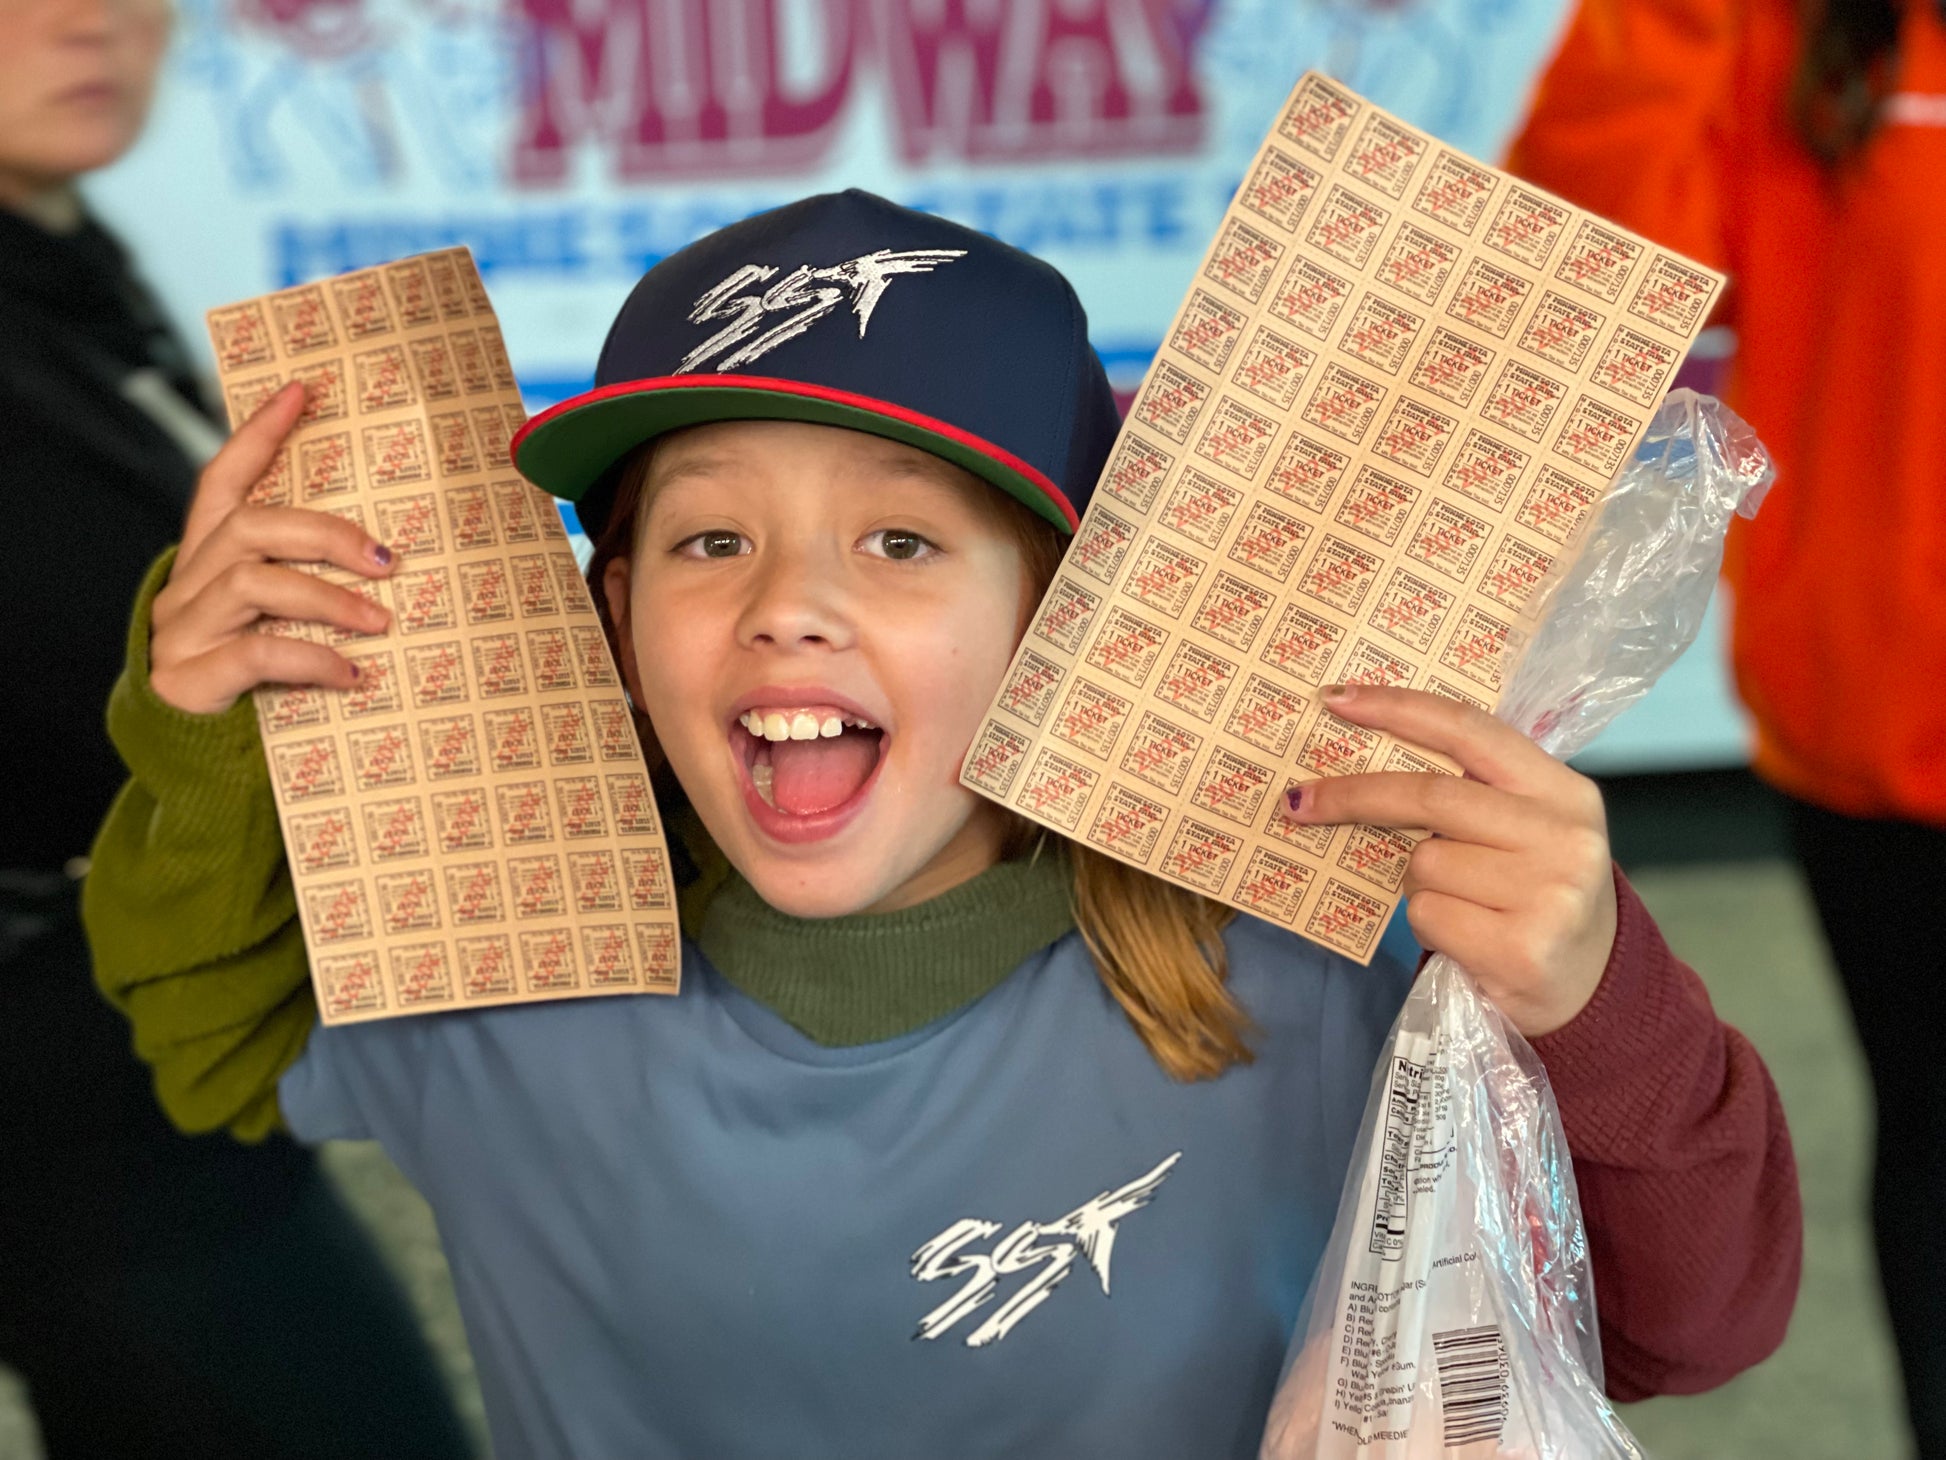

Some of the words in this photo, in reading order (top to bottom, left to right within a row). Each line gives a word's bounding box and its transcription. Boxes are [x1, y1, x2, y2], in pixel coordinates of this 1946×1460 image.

[1512, 198, 1537, 214] STATE
[1517, 191, 1564, 218] MINNESOTA
[1514, 214, 1545, 234] TICKET
[1403, 234, 1428, 250] STATE
[1408, 227, 1454, 255] MINNESOTA
[1534, 230, 1557, 263] 0007135
[1406, 250, 1436, 270] TICKET
[1296, 268, 1321, 285] STATE
[1302, 261, 1346, 289] MINNESOTA
[1425, 266, 1447, 300] 0007135
[1657, 267, 1683, 283] STATE
[1662, 260, 1710, 286] MINNESOTA
[1299, 283, 1328, 304] TICKET
[1659, 282, 1691, 302] TICKET
[1317, 301, 1340, 334] 0007135
[1546, 302, 1572, 318] STATE
[1552, 296, 1598, 322] MINNESOTA
[1679, 298, 1703, 331] 0007135
[1549, 318, 1579, 337] TICKET
[1437, 339, 1462, 354] STATE
[1442, 332, 1488, 358] MINNESOTA
[1568, 334, 1591, 366] 0007135
[1440, 354, 1470, 373] TICKET
[1329, 375, 1354, 390] STATE
[1335, 368, 1380, 394] MINNESOTA
[1459, 369, 1482, 401] 0007135
[1332, 390, 1362, 409] TICKET
[1223, 408, 1248, 425] STATE
[1228, 402, 1273, 429] MINNESOTA
[1351, 406, 1373, 438] 0007135
[1581, 407, 1607, 423] STATE
[1587, 400, 1634, 427] MINNESOTA
[1225, 424, 1255, 444] TICKET
[1584, 422, 1615, 442] TICKET
[1244, 441, 1266, 474] 0007135
[1471, 441, 1497, 457] STATE
[1477, 434, 1523, 461] MINNESOTA
[1604, 439, 1627, 472] 0007135
[1474, 456, 1504, 476] TICKET
[1363, 477, 1388, 492] STATE
[1368, 470, 1414, 496] MINNESOTA
[1493, 473, 1516, 506] 0007135
[1365, 492, 1395, 511] TICKET
[1256, 513, 1281, 529] STATE
[1261, 506, 1306, 532] MINNESOTA
[1384, 507, 1407, 540] 0007135
[1258, 528, 1288, 548] TICKET
[1150, 548, 1174, 565] STATE
[1155, 542, 1200, 569] MINNESOTA
[1276, 544, 1299, 576] 0007135
[1152, 564, 1181, 584] TICKET
[1170, 580, 1193, 613] 0007135
[1396, 580, 1422, 597] STATE
[1402, 573, 1448, 602] MINNESOTA
[1399, 596, 1429, 617] TICKET
[1288, 616, 1313, 631] STATE
[1294, 609, 1339, 635] MINNESOTA
[1418, 613, 1441, 647] 0007135
[1290, 631, 1320, 650] TICKET
[1182, 652, 1206, 668] STATE
[1187, 645, 1232, 672] MINNESOTA
[1309, 647, 1332, 680] 0007135
[1184, 667, 1213, 687] TICKET
[1077, 689, 1101, 705] STATE
[1082, 682, 1126, 709] MINNESOTA
[1203, 683, 1225, 716] 0007135
[1080, 704, 1109, 724] TICKET
[1099, 720, 1120, 754] 0007135
[1216, 759, 1242, 774] STATE
[1221, 752, 1268, 777] MINNESOTA
[1220, 774, 1250, 792] TICKET
[1112, 795, 1137, 811] STATE
[1117, 788, 1163, 814] MINNESOTA
[1242, 789, 1263, 821] 0007135
[1116, 810, 1146, 829] TICKET
[1137, 826, 1158, 858] 0007135
[1258, 858, 1283, 872] STATE
[1262, 851, 1309, 875] MINNESOTA
[1261, 872, 1292, 890] TICKET
[1283, 886, 1304, 918] 0007135
